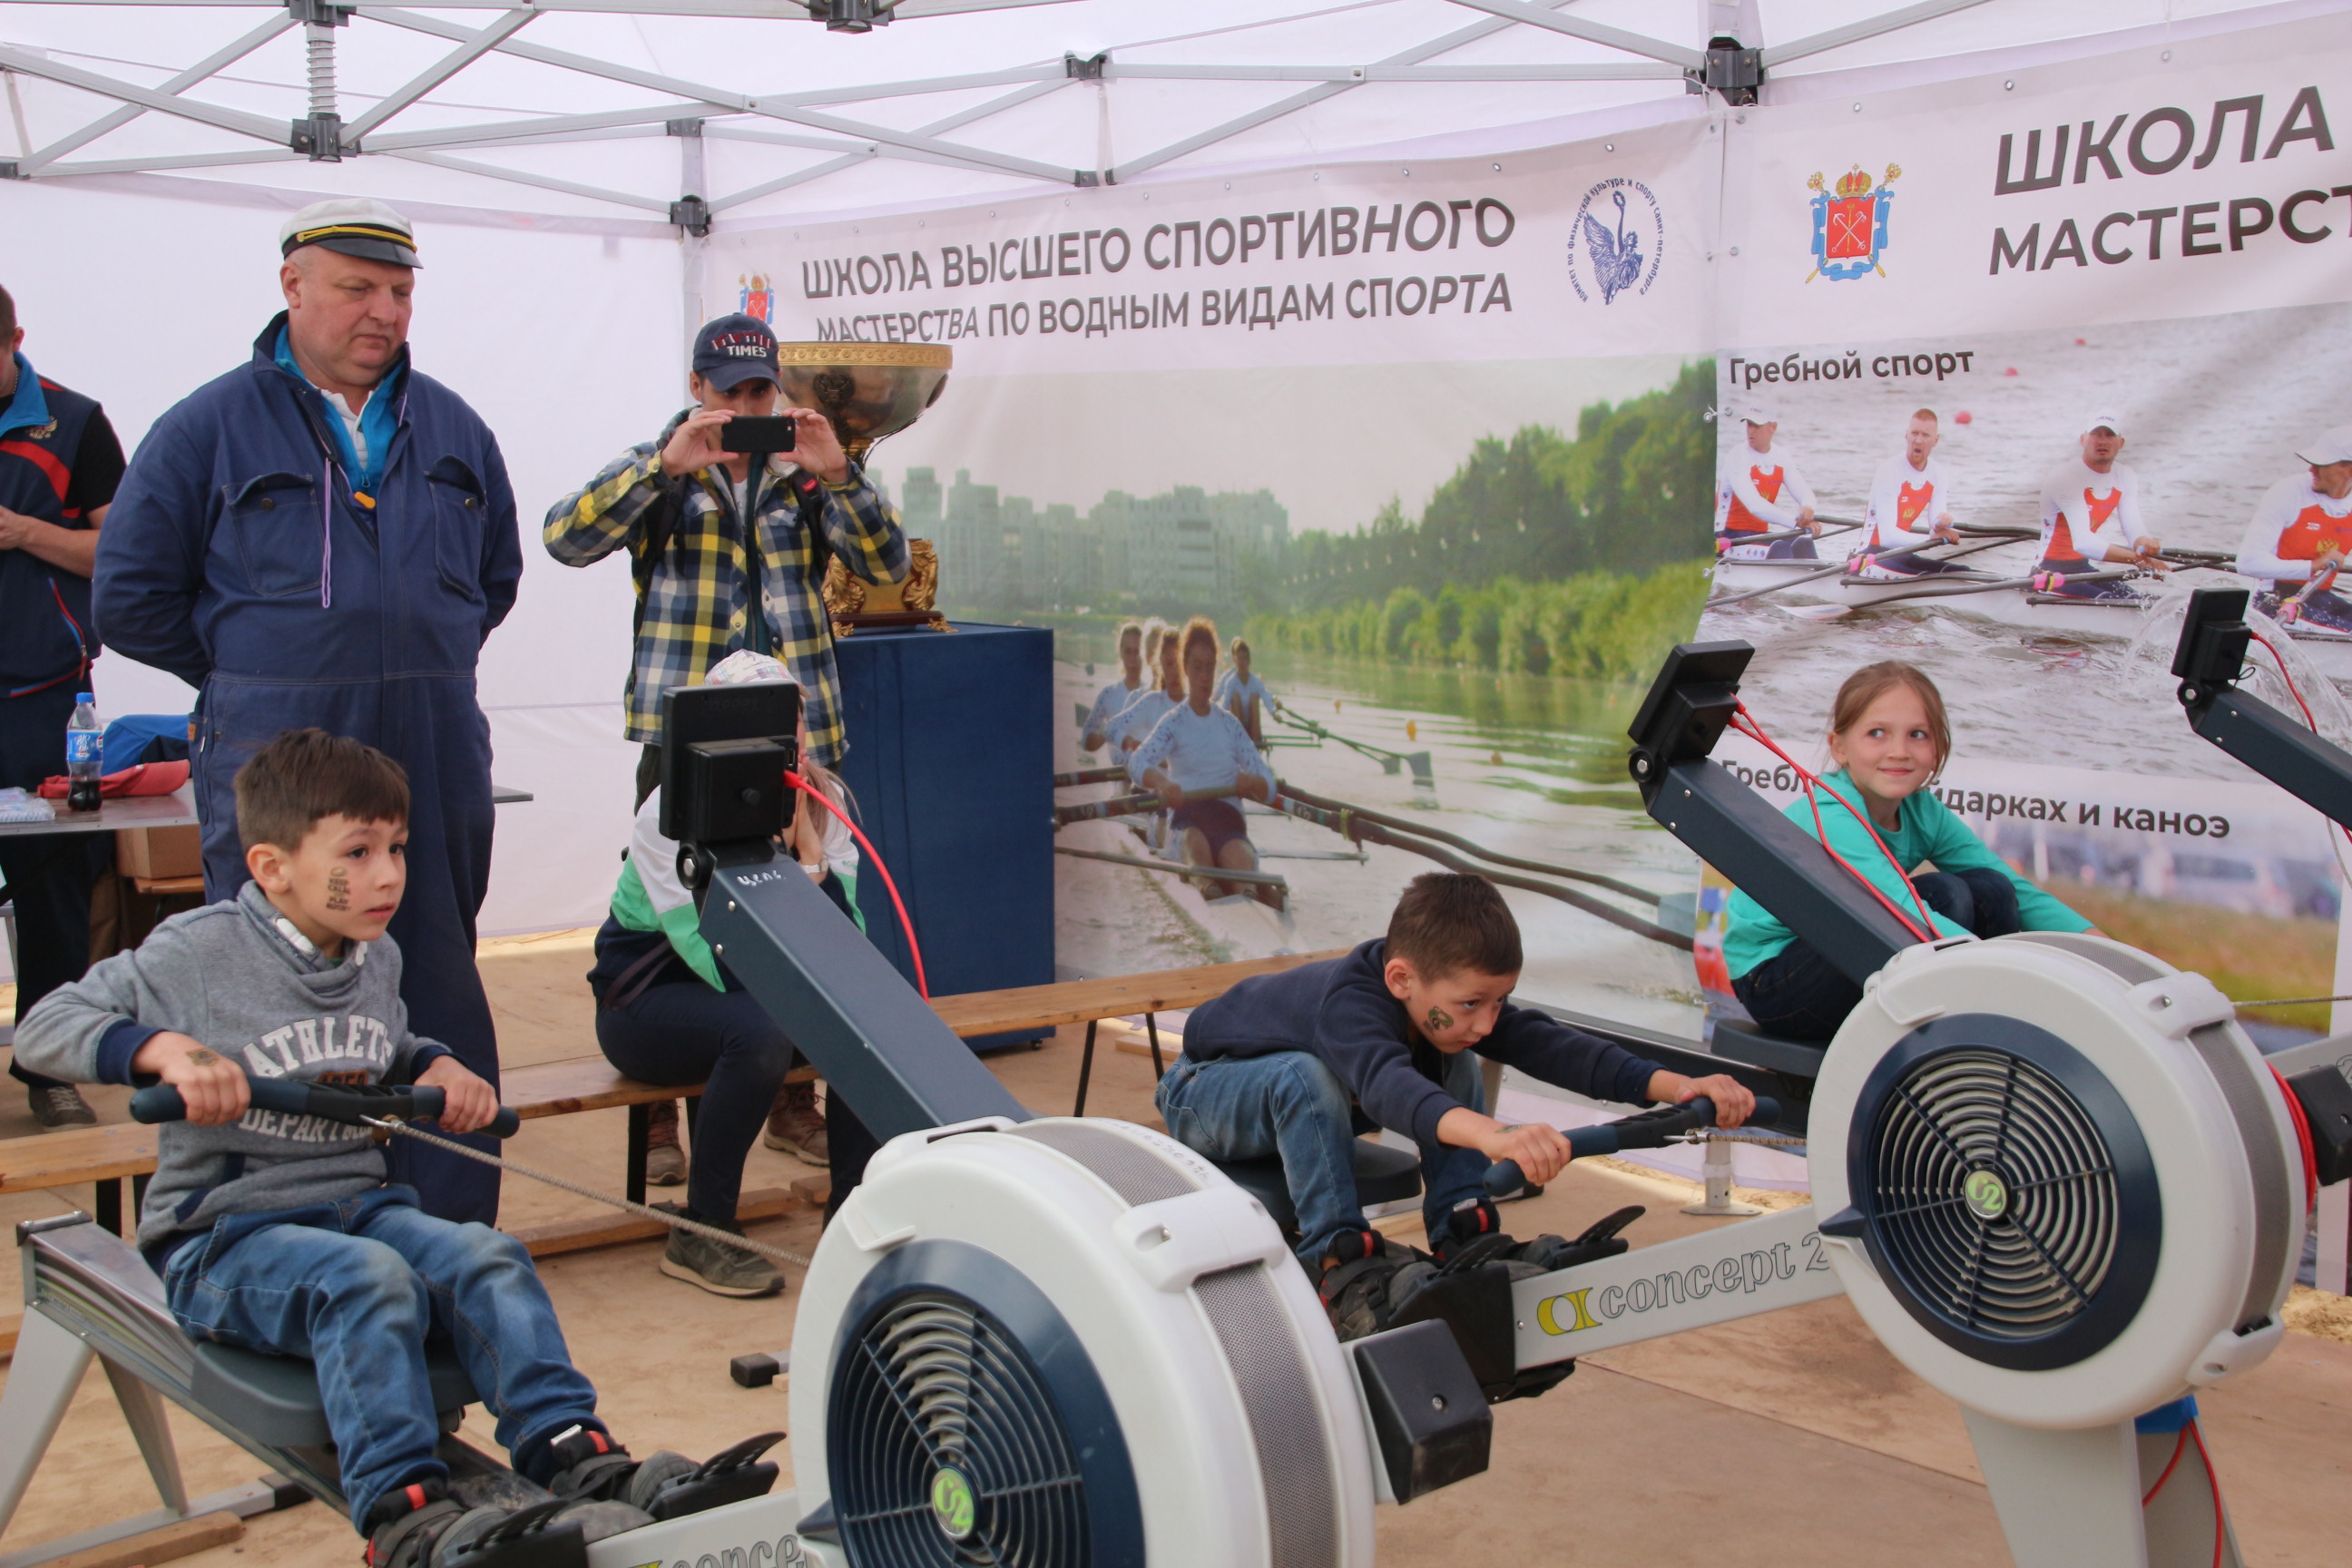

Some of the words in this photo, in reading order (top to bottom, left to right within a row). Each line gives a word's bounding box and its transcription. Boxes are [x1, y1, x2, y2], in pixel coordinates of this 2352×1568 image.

[1994, 85, 2335, 195] ШКОЛА
[803, 251, 931, 299] ШКОЛА
[941, 228, 1132, 288] ВЫСШЕГО
[1144, 197, 1515, 270] СПОРТИВНОГО
[817, 307, 979, 341] МАСТЕРСТВА
[989, 302, 1029, 338] ПО
[1039, 292, 1190, 338] ВОДНЫМ
[1202, 282, 1334, 330] ВИДАМ
[1346, 273, 1513, 318] СПОРТА
[727, 346, 767, 358] TIMES
[1730, 350, 1862, 390] Гребной
[1872, 350, 1974, 382] спорт
[2079, 801, 2100, 826] и
[2112, 807, 2230, 839] каноэ
[1599, 1242, 1796, 1318] concept
[1802, 1230, 1830, 1271] 2
